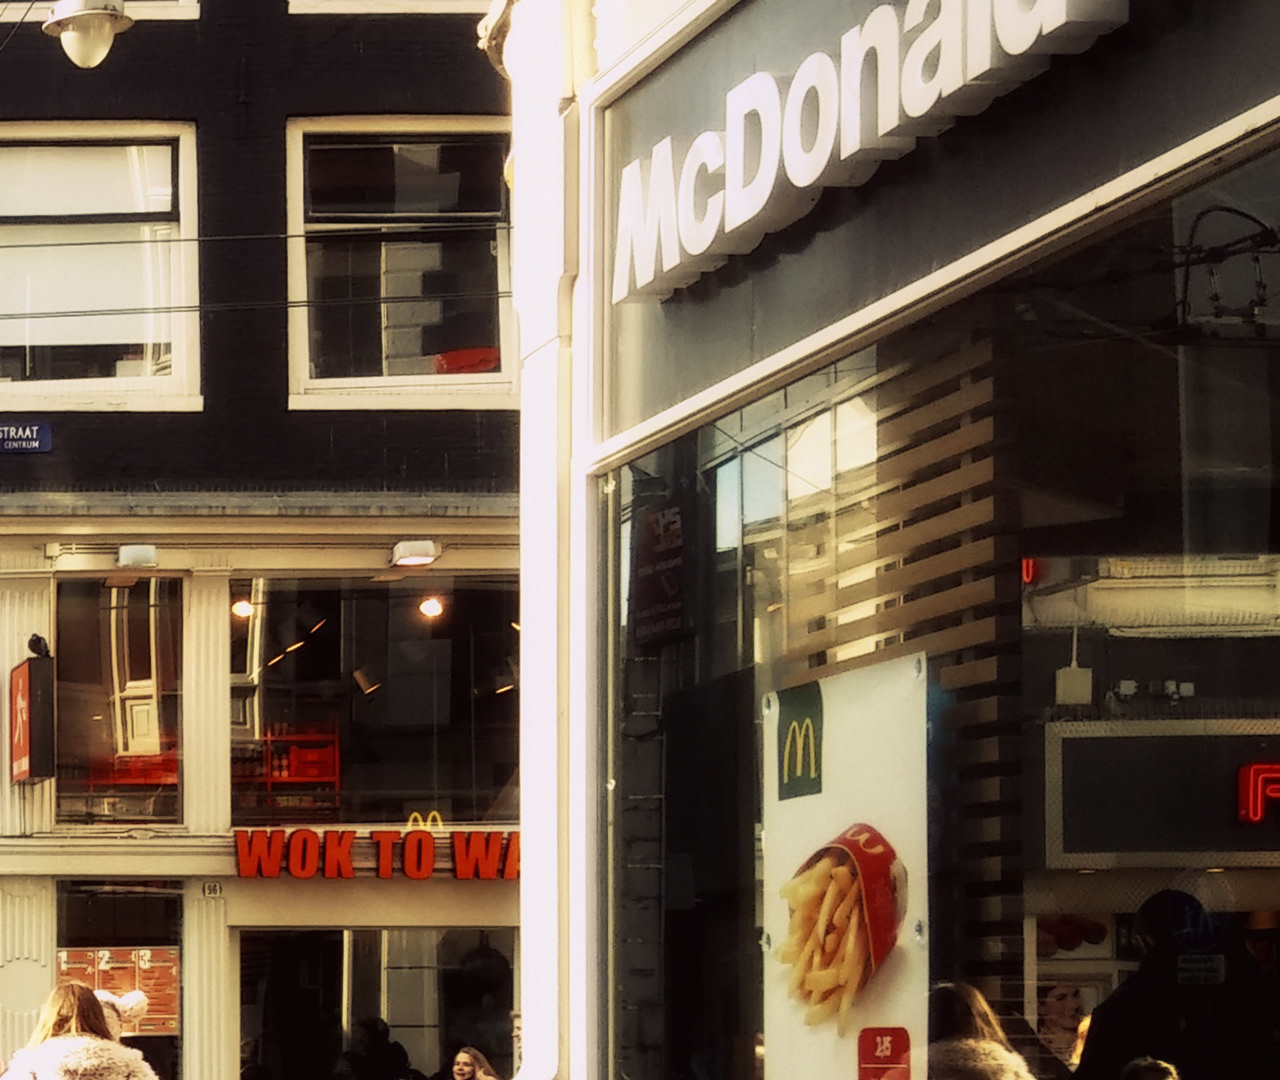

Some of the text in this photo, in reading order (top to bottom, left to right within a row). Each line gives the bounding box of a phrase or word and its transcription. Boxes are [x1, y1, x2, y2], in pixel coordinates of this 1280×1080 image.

[3, 440, 40, 449] CENTRUM
[234, 829, 356, 879] WOK
[371, 829, 436, 880] TO
